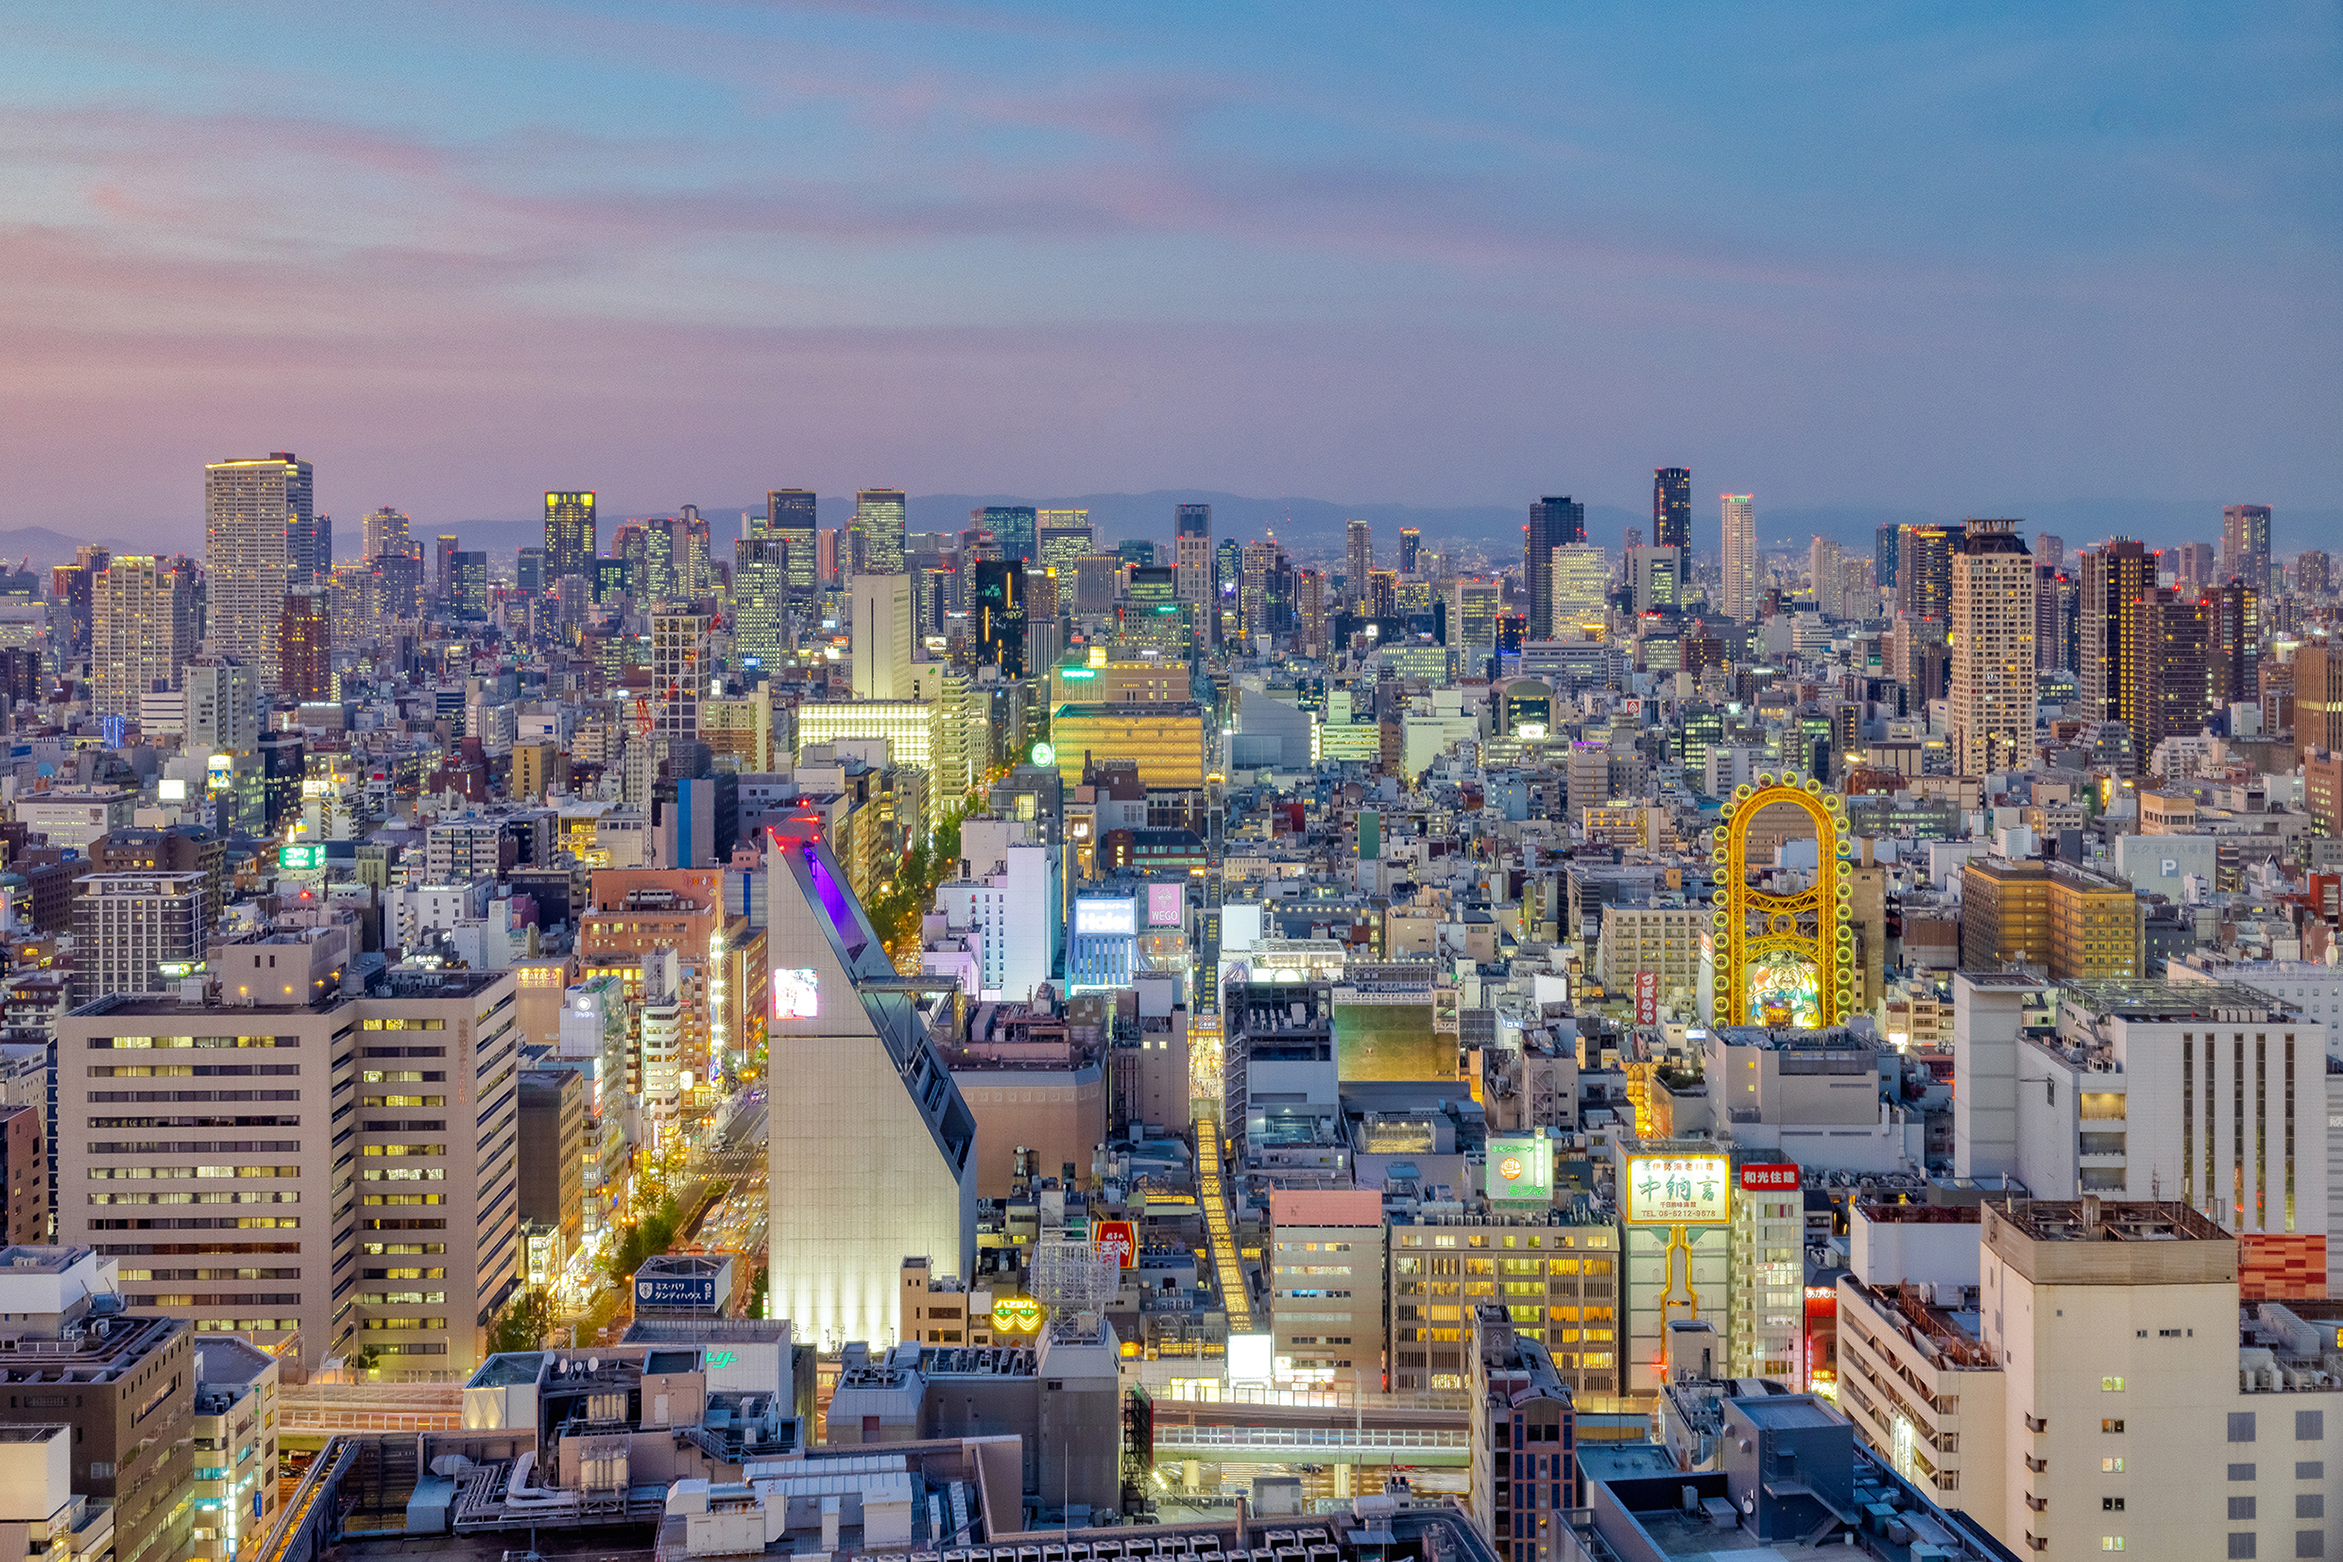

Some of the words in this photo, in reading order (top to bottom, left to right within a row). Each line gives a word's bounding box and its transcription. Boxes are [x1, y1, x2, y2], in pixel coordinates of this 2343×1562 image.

[2162, 859, 2177, 876] P
[1079, 911, 1132, 930] Haier
[1151, 910, 1178, 921] WEGO
[1744, 1171, 1796, 1184] 和光住建
[1637, 1173, 1720, 1203] 中納言
[655, 1291, 702, 1300] ダンディハウス
